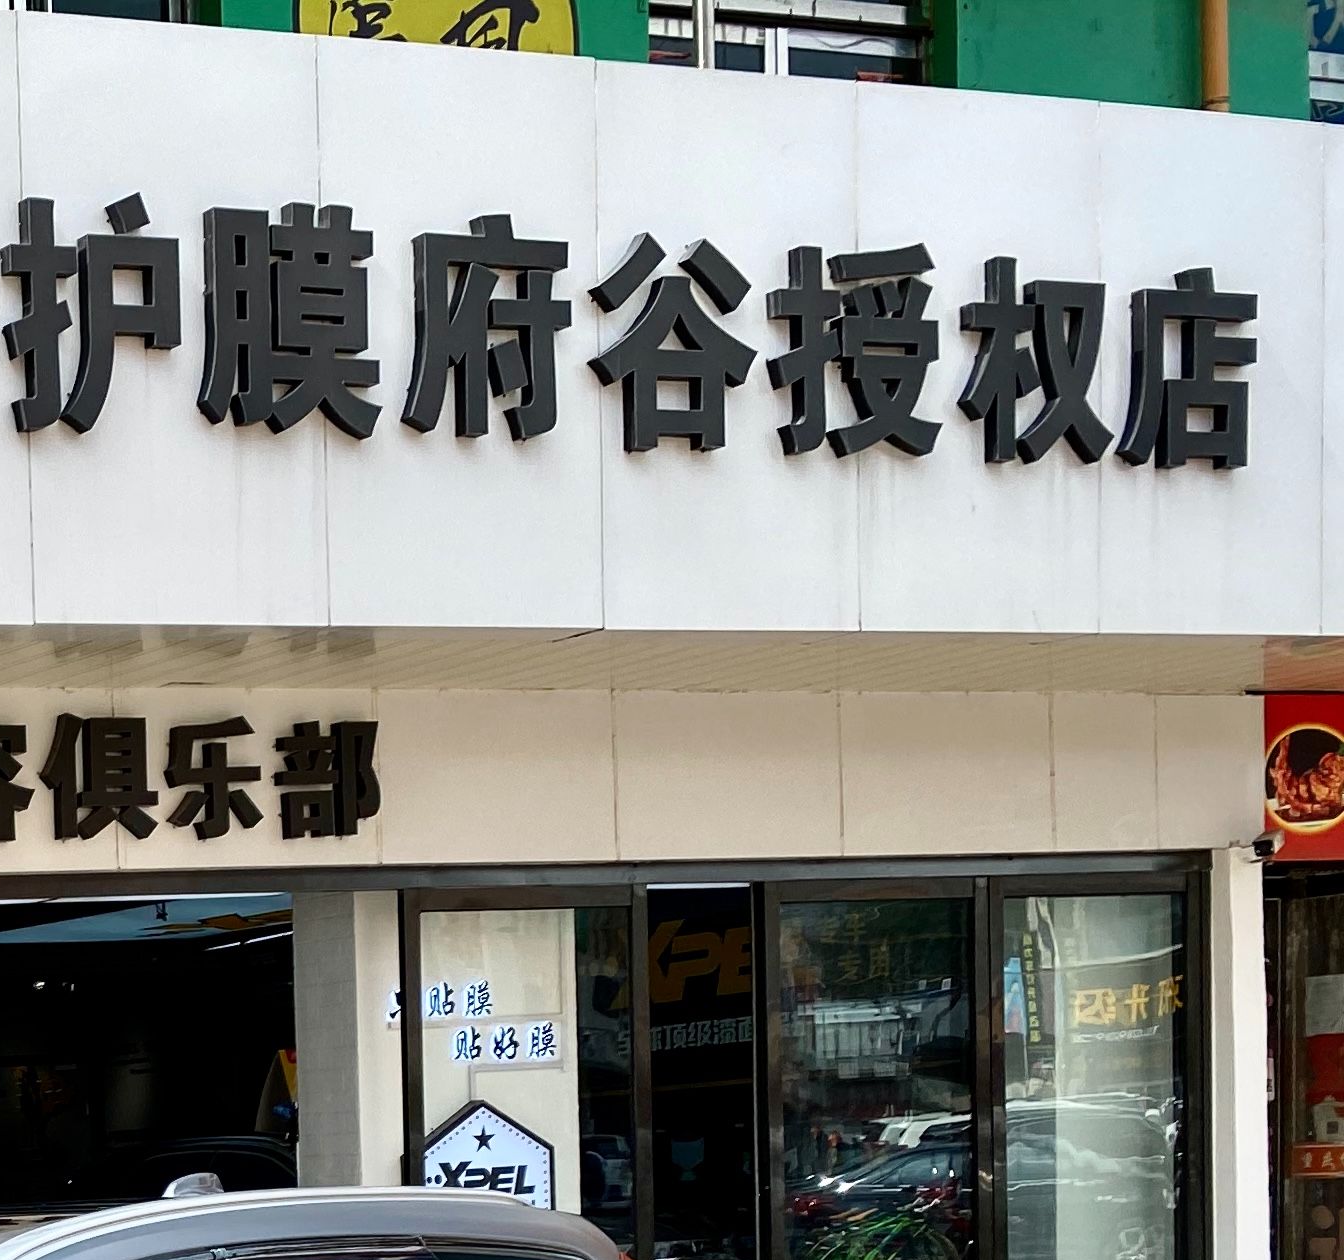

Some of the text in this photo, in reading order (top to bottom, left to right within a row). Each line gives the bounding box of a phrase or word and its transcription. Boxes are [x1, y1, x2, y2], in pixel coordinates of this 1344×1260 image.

[454, 1022, 558, 1061] 贴好膜
[437, 1161, 536, 1195] XPEL
